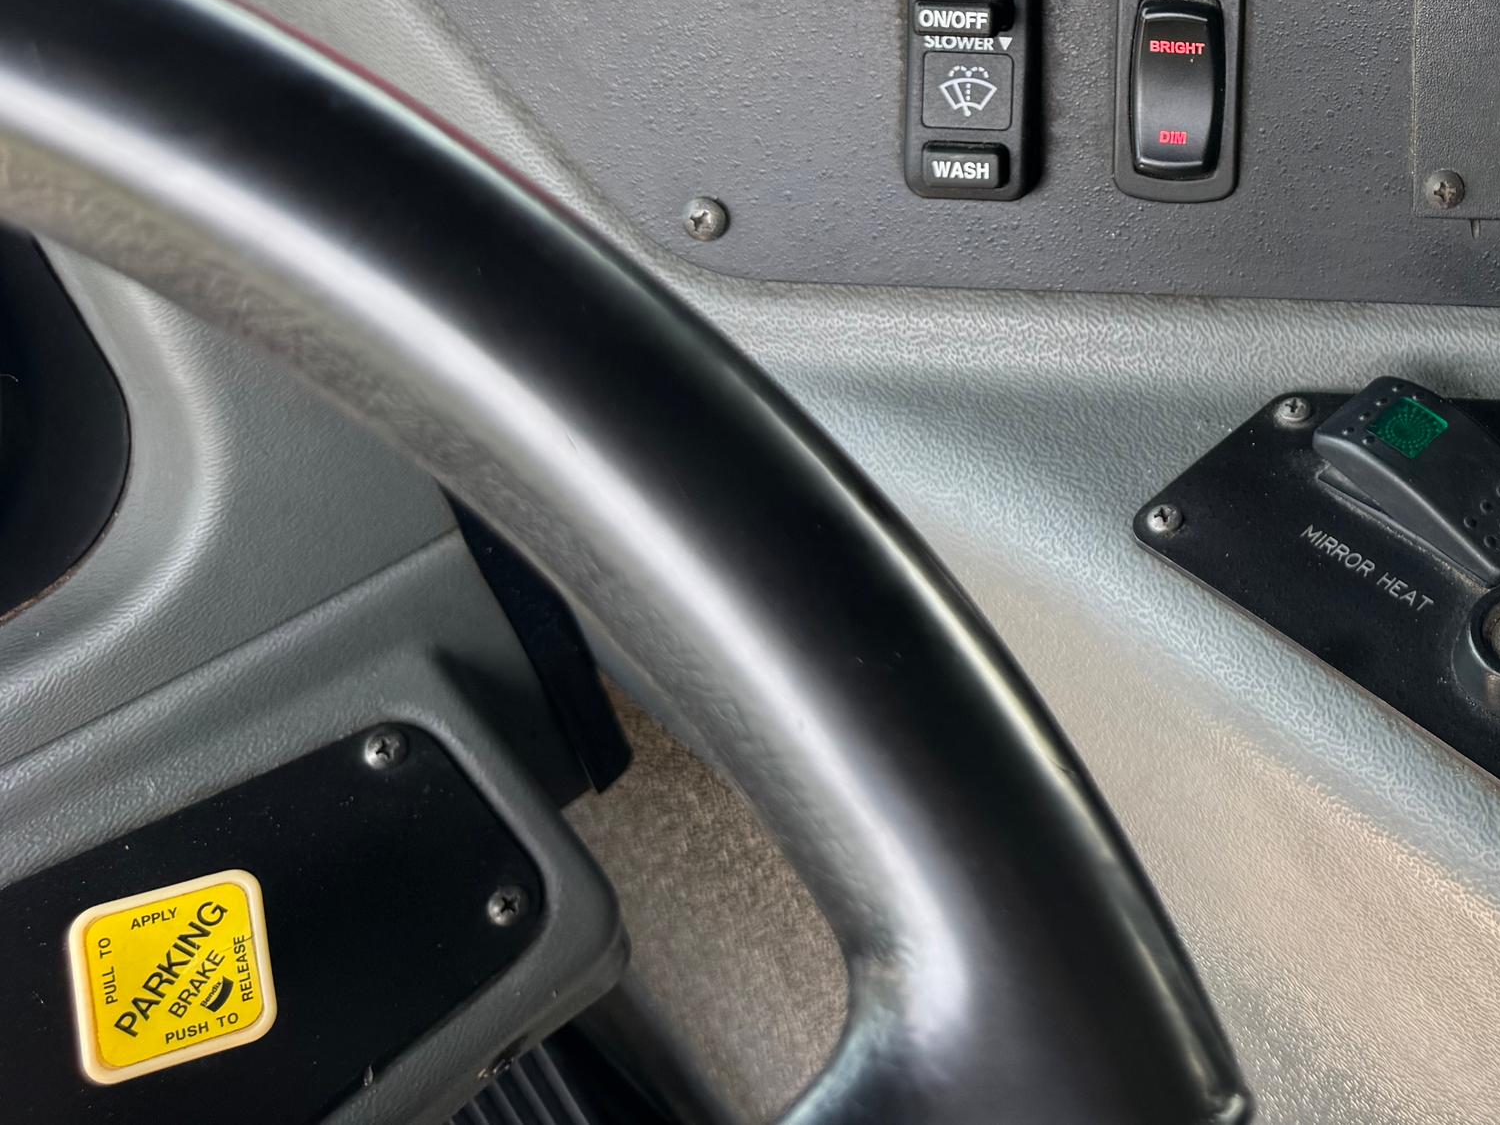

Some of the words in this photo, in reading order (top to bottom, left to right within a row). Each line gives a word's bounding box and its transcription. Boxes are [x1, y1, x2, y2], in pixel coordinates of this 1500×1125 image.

[919, 9, 988, 29] ON/OFF
[924, 35, 994, 50] SLOWER
[1149, 40, 1205, 55] BRIGHT
[1159, 131, 1187, 144] DIM
[932, 160, 990, 179] WASH
[1300, 524, 1376, 577] MIRROR
[1376, 572, 1434, 611] HEAT
[130, 907, 178, 930] APPLY
[98, 937, 112, 958] TO
[114, 901, 228, 1038] PARKING
[233, 935, 254, 1003] RELEASE
[103, 967, 118, 1005] PULL
[168, 949, 226, 1019] BRAKE
[200, 980, 222, 1008] Bendix
[165, 1021, 209, 1044] PUSH
[216, 1012, 239, 1028] TO
